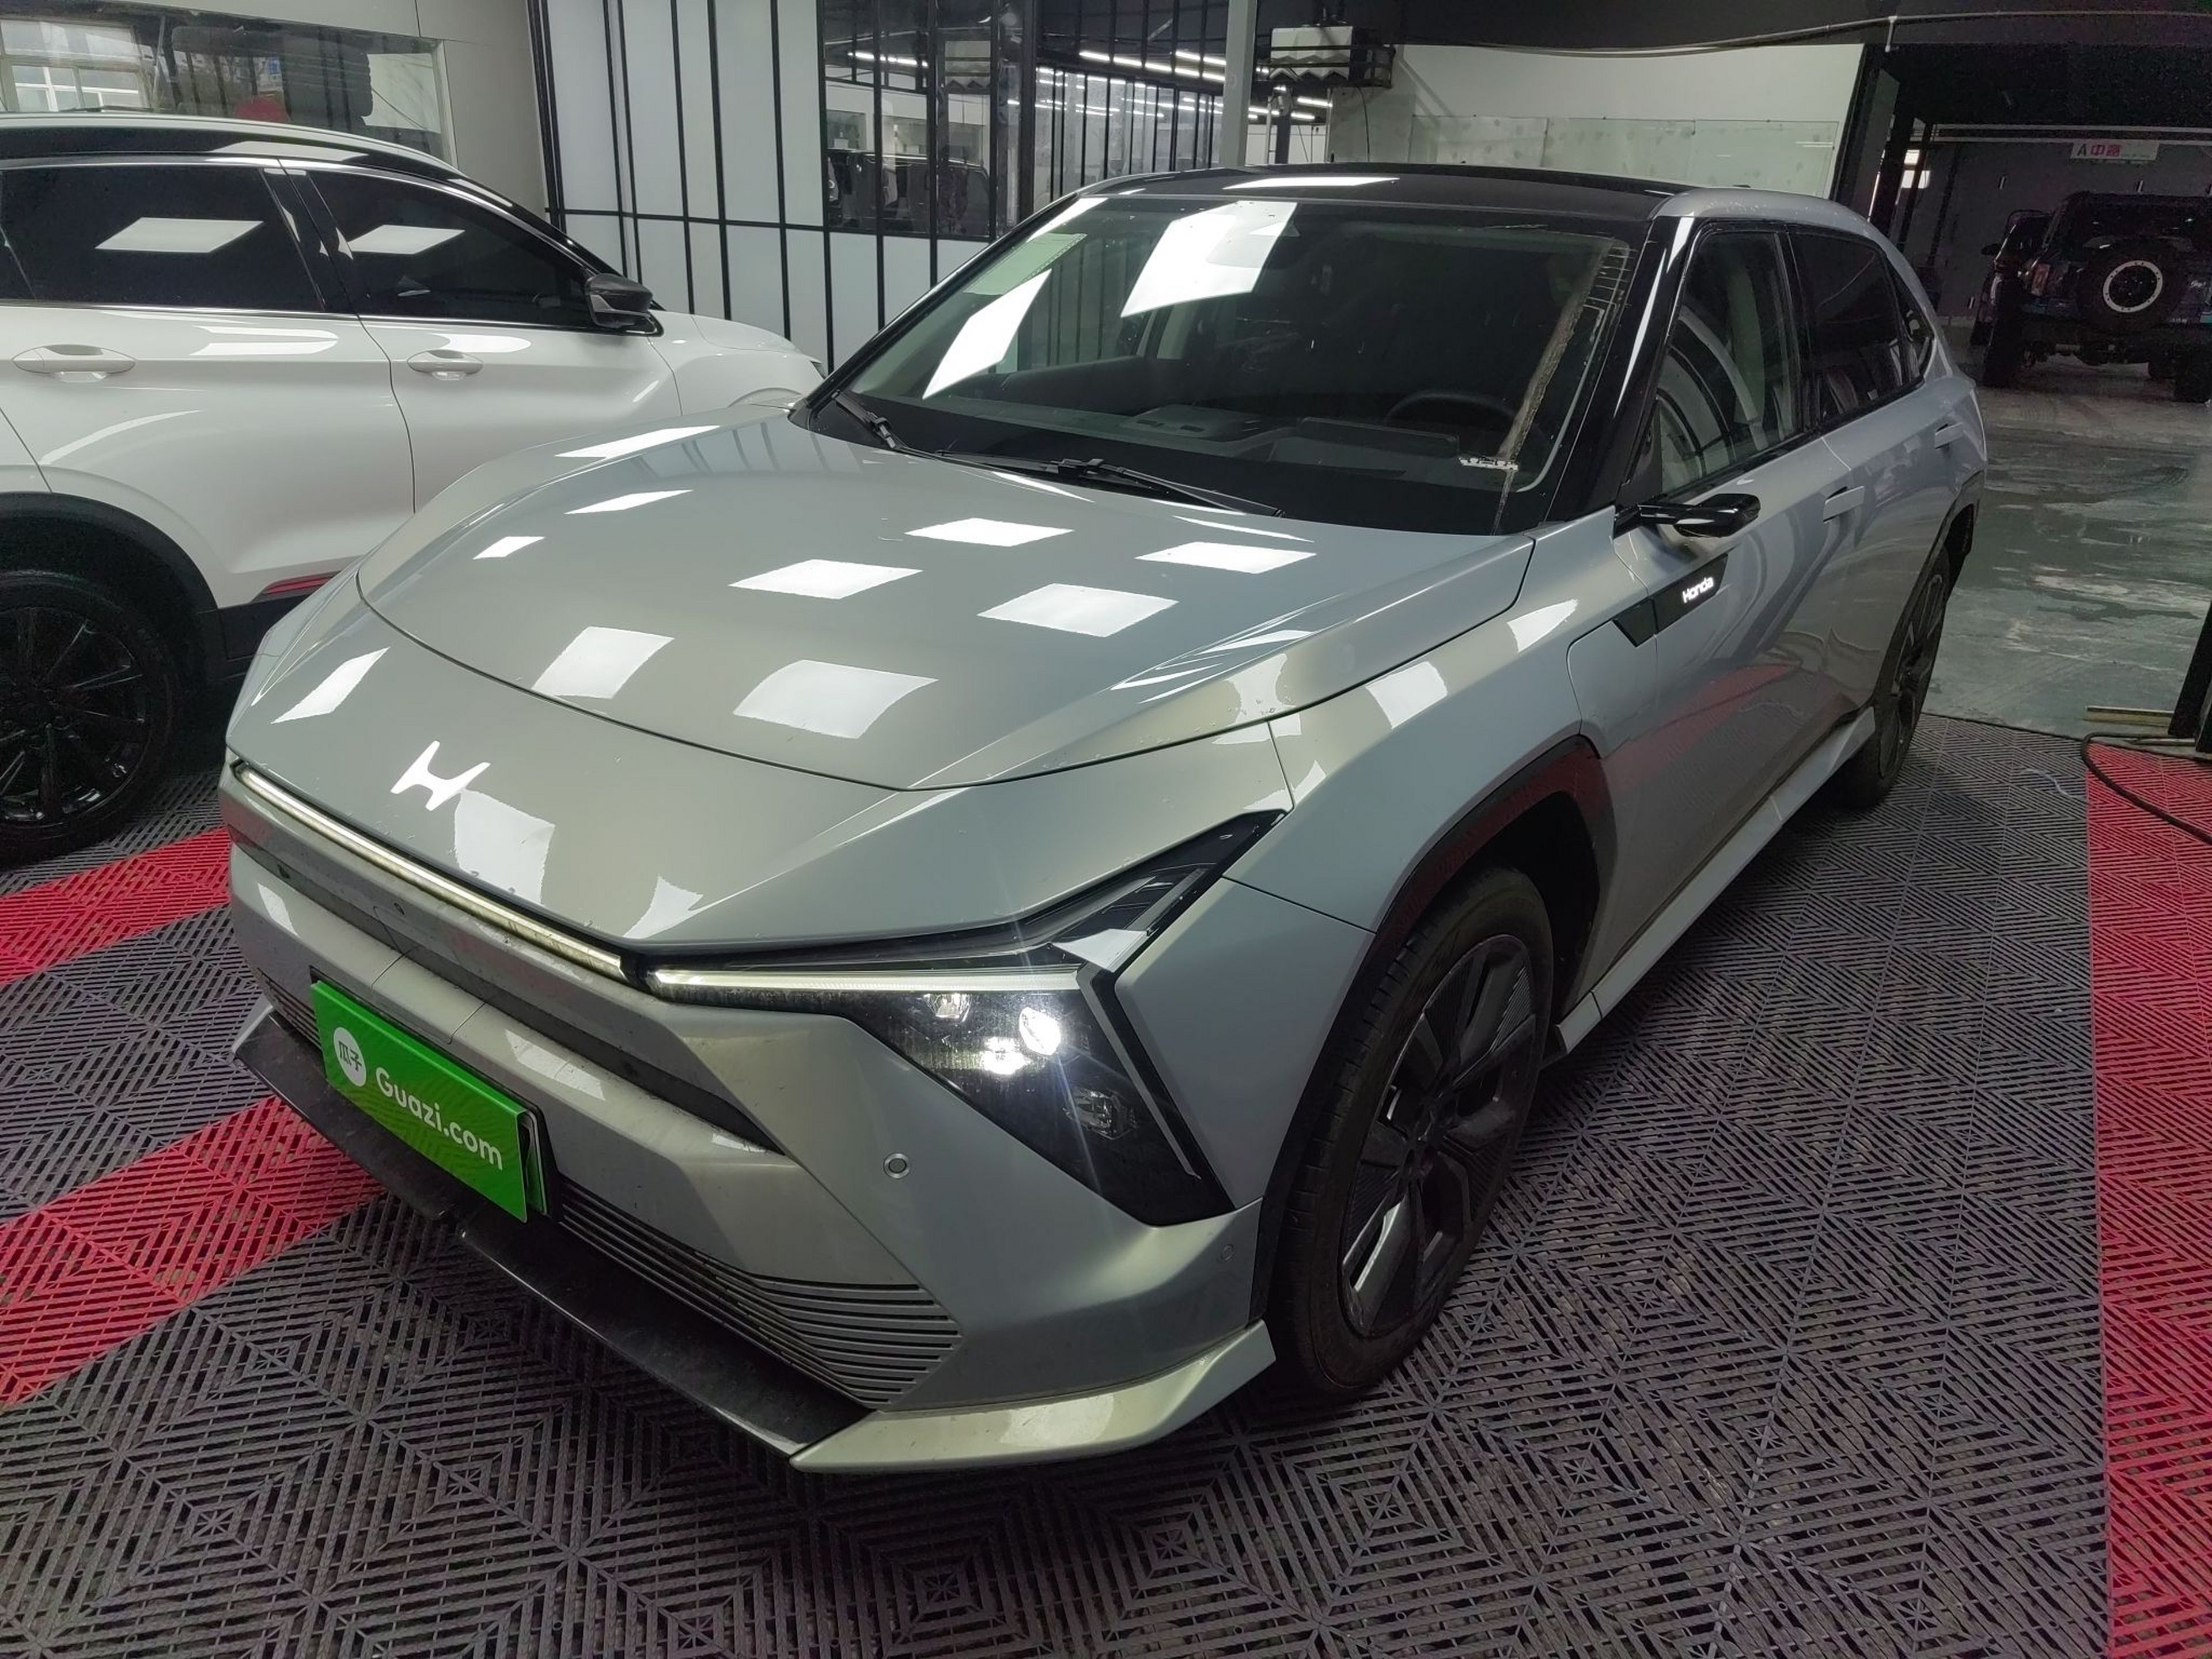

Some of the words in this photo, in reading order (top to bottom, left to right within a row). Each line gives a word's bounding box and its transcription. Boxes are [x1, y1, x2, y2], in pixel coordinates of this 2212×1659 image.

[1682, 577, 1714, 604] Honda
[338, 1040, 362, 1072] 瓜子
[376, 1067, 503, 1171] Guazi.com
